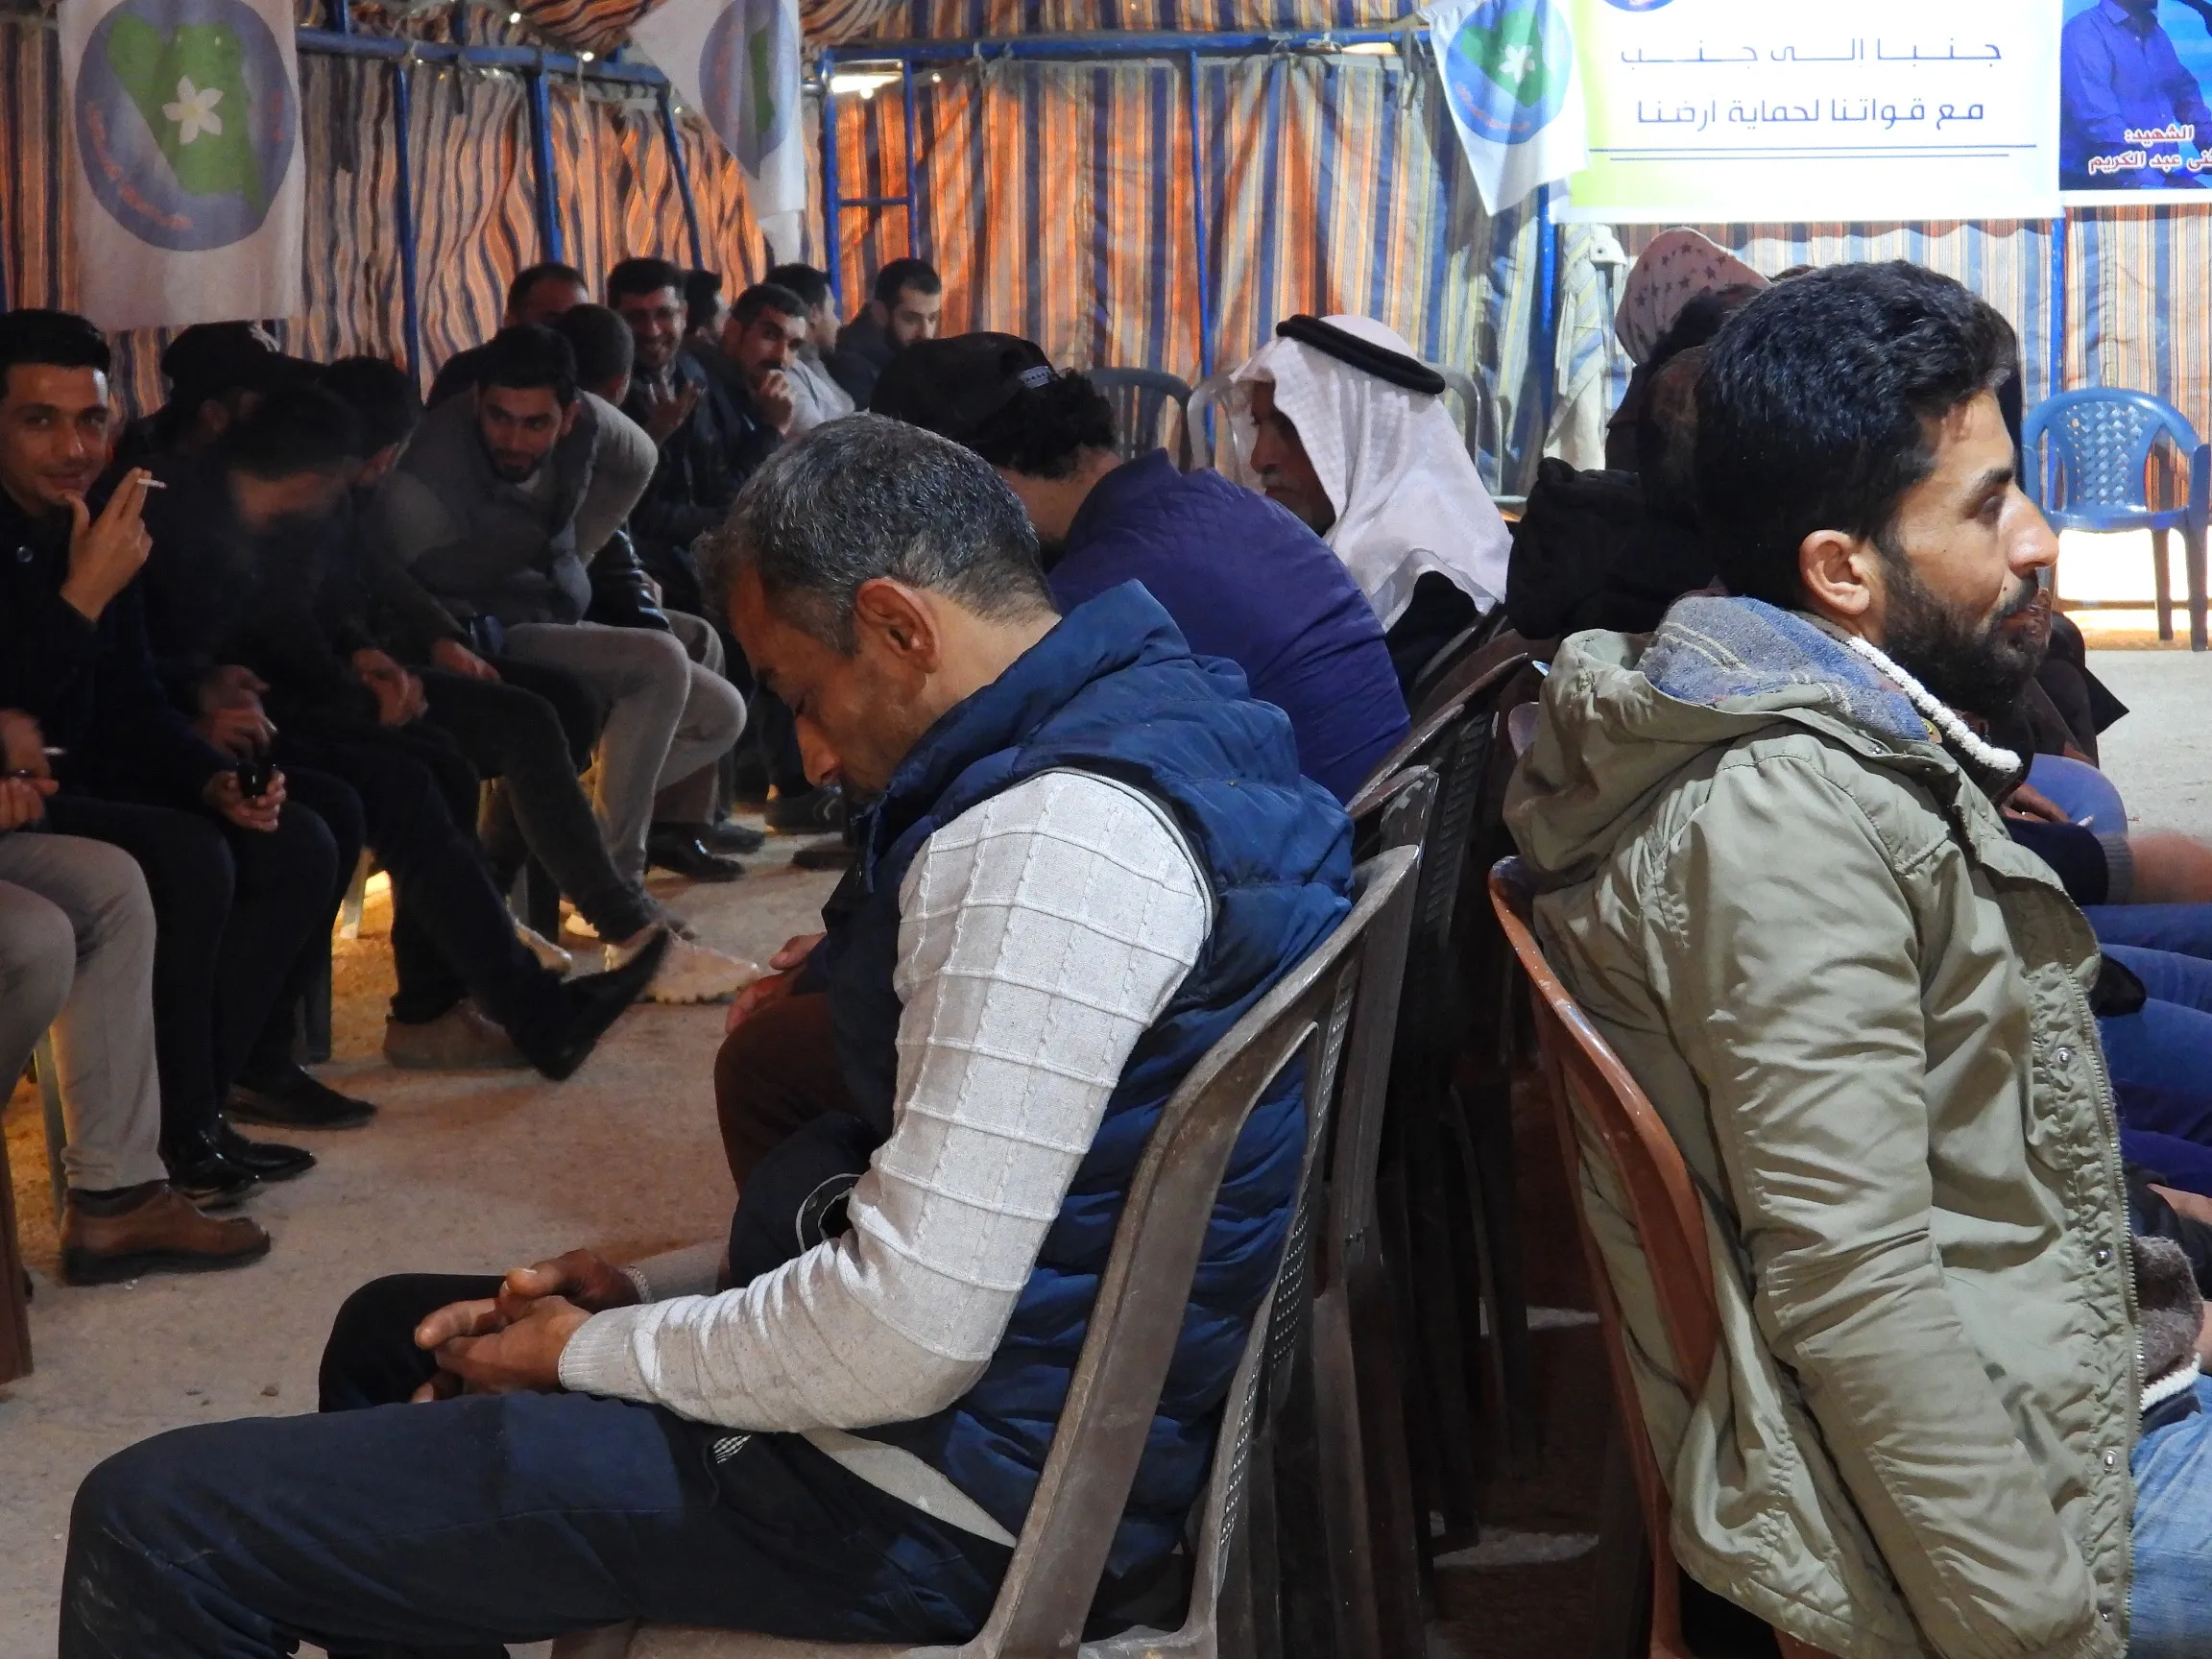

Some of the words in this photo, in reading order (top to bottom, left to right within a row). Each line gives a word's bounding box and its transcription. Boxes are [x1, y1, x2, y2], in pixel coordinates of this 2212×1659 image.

[1621, 39, 1759, 71] جنب
[1877, 37, 2002, 67] جنبا
[1728, 98, 1819, 130] لحماية
[1831, 98, 1925, 131] قواتنا
[1936, 103, 1984, 131] مع
[2088, 151, 2147, 175] الكريم
[2149, 154, 2182, 173] عبد
